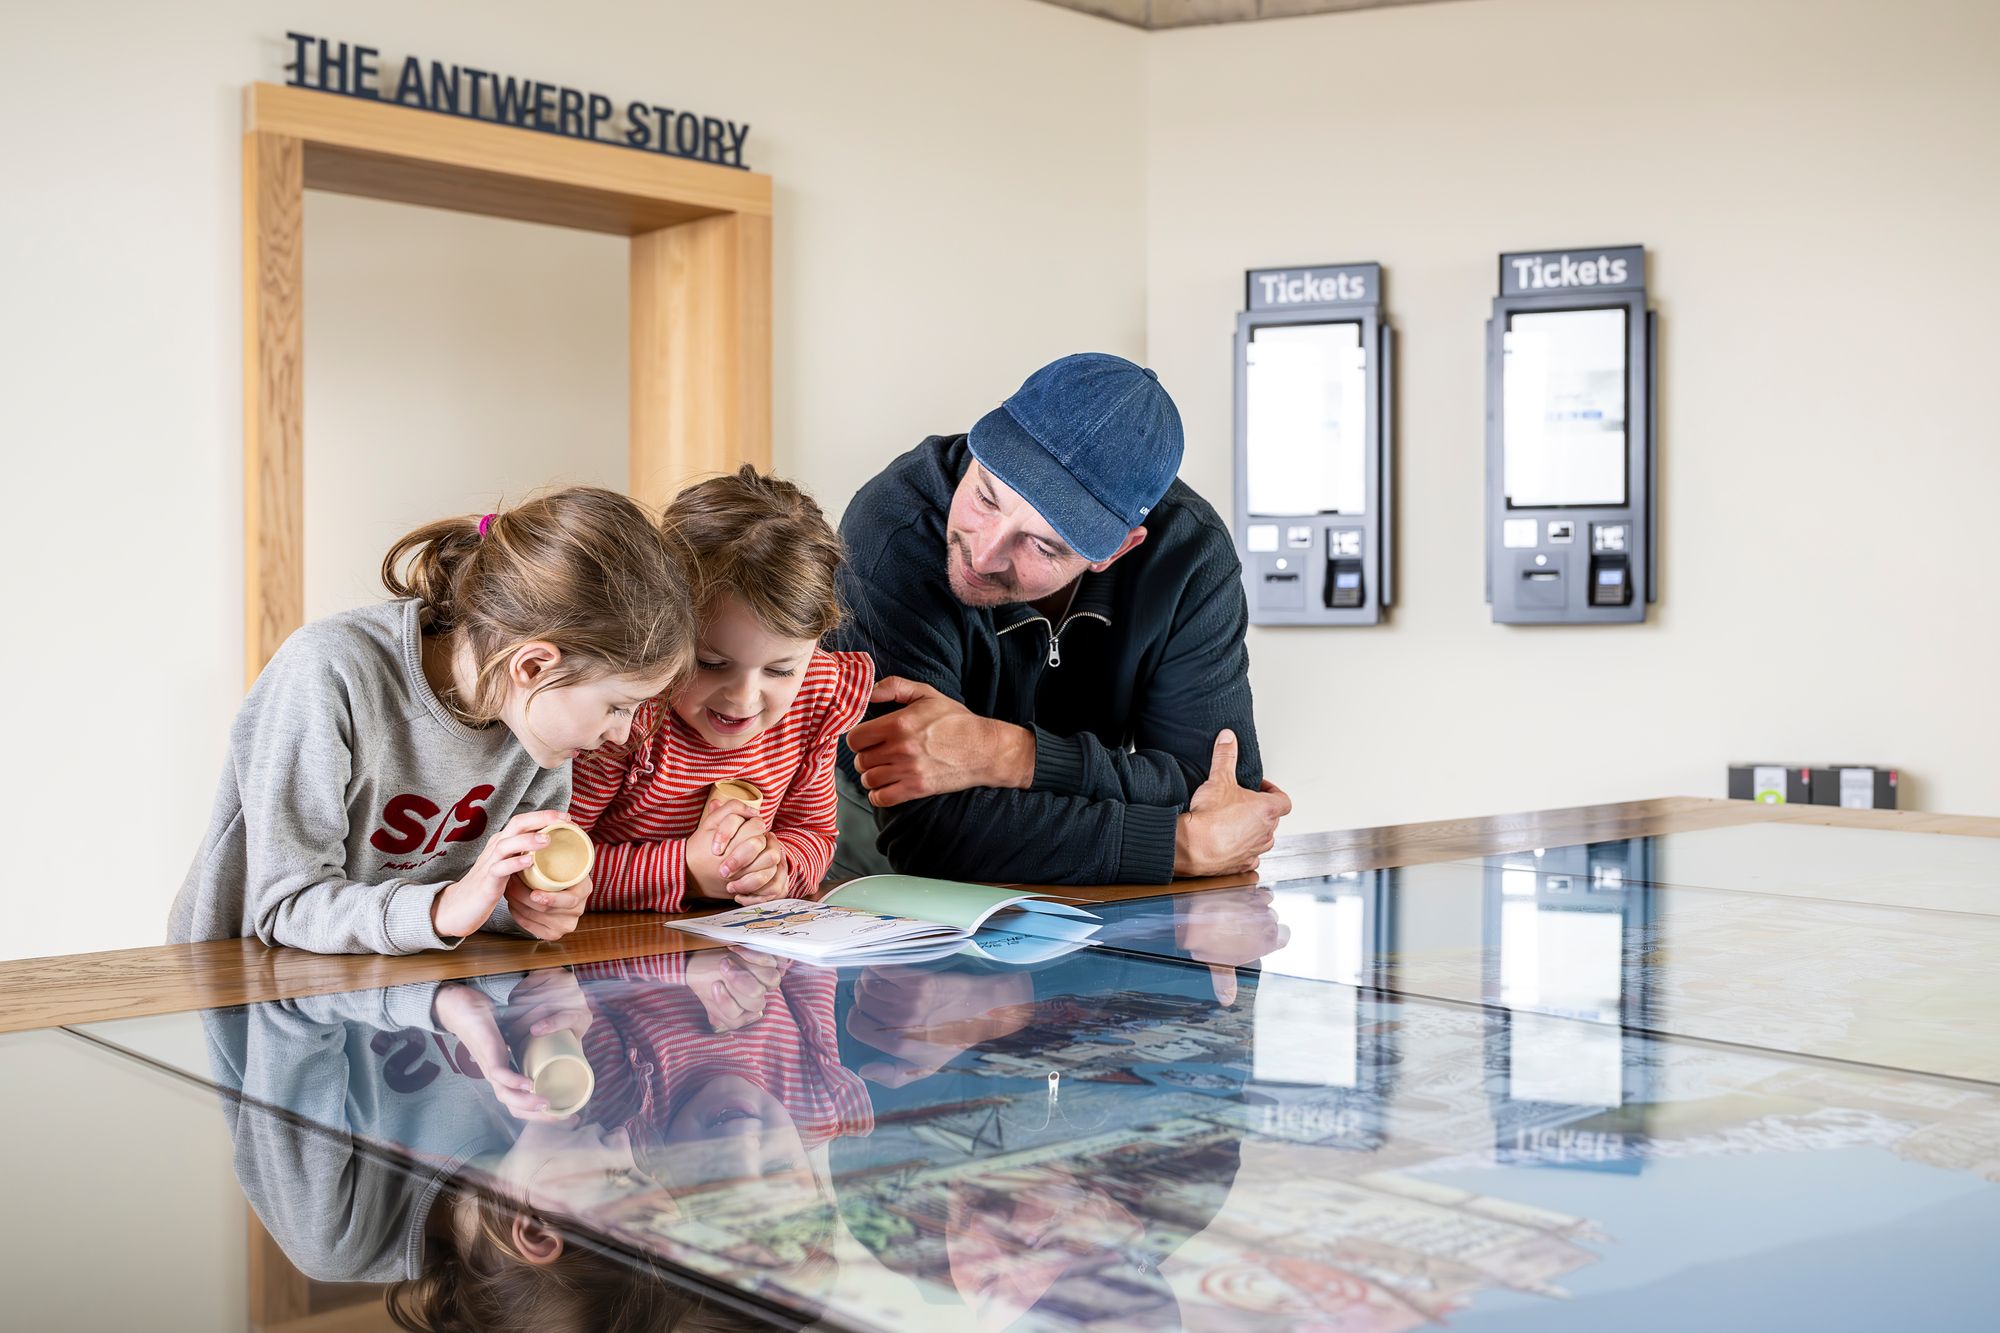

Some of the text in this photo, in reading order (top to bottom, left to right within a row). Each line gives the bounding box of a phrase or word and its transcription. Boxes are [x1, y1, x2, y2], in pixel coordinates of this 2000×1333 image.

[286, 31, 750, 170] THE ANTWERP STORY
[1259, 271, 1365, 304] Tickets
[1512, 254, 1628, 289] Tickets
